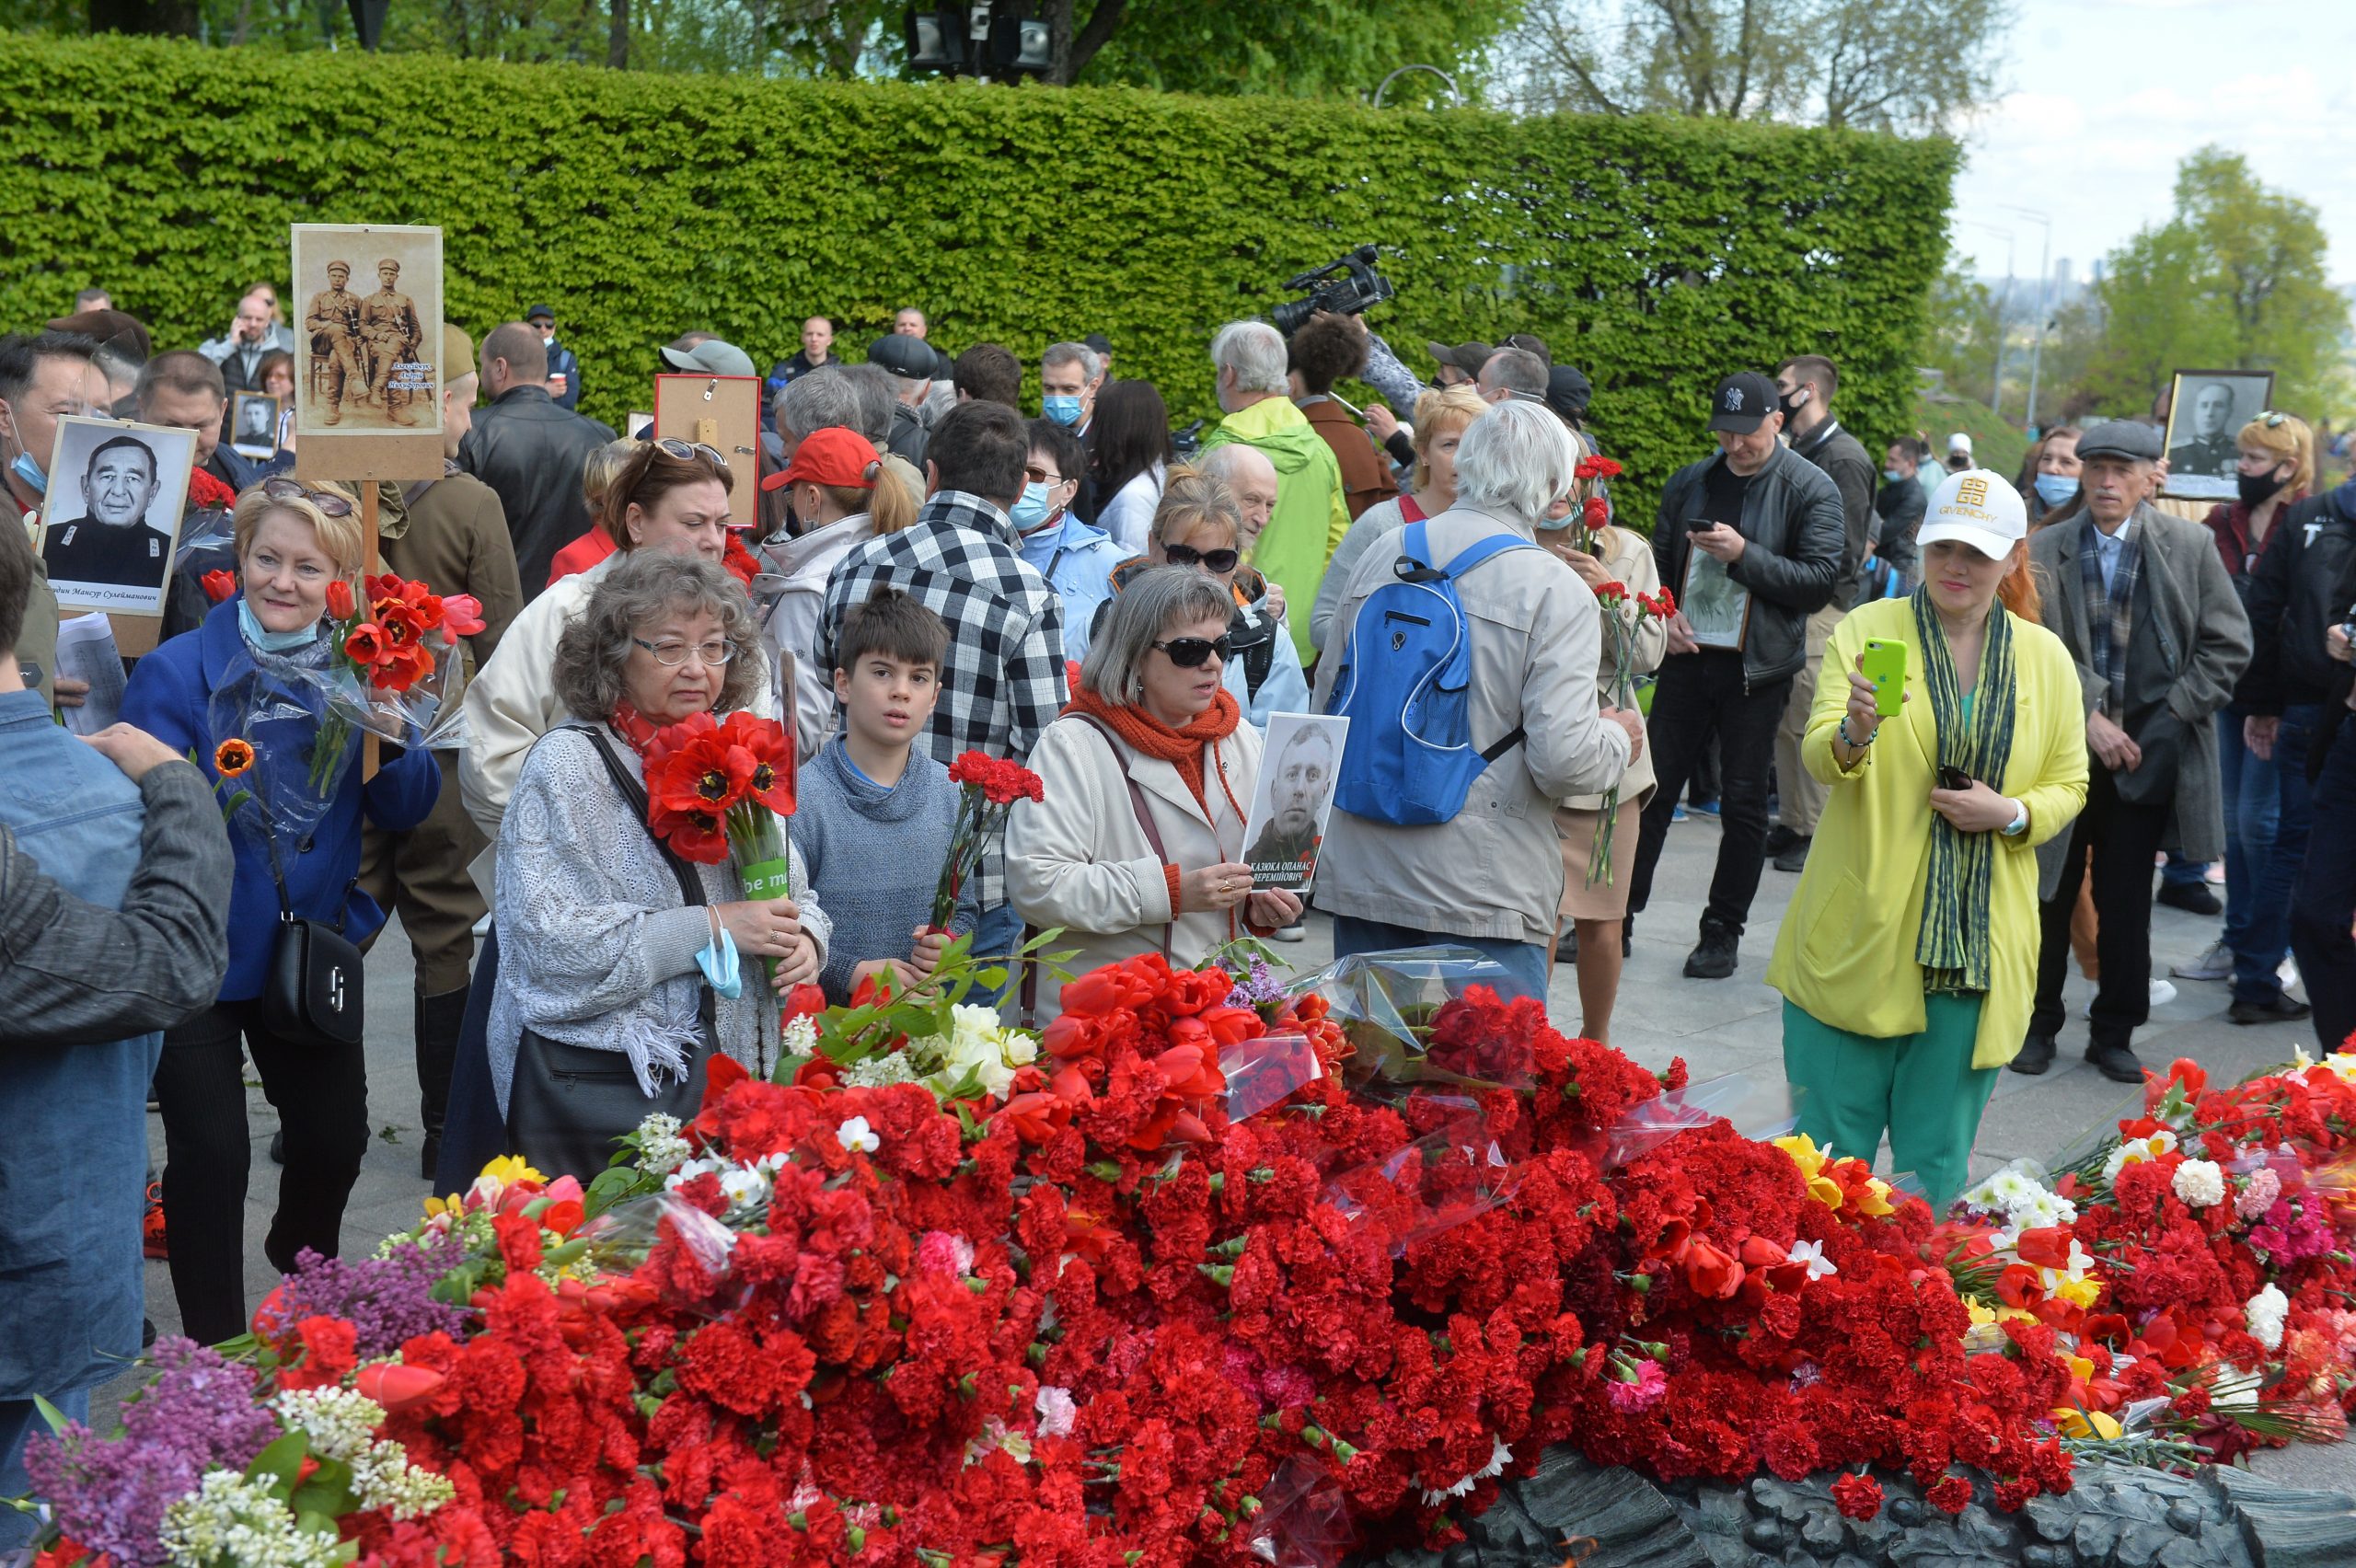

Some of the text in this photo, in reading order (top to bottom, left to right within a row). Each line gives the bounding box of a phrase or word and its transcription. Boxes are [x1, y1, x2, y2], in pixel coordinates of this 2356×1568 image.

[1939, 505, 1998, 524] GIVENCHY
[72, 587, 102, 599] Мансур
[103, 590, 157, 602] Сулейманович
[1251, 861, 1311, 872] КАЗЮКА ОПАНАС
[742, 878, 764, 894] be
